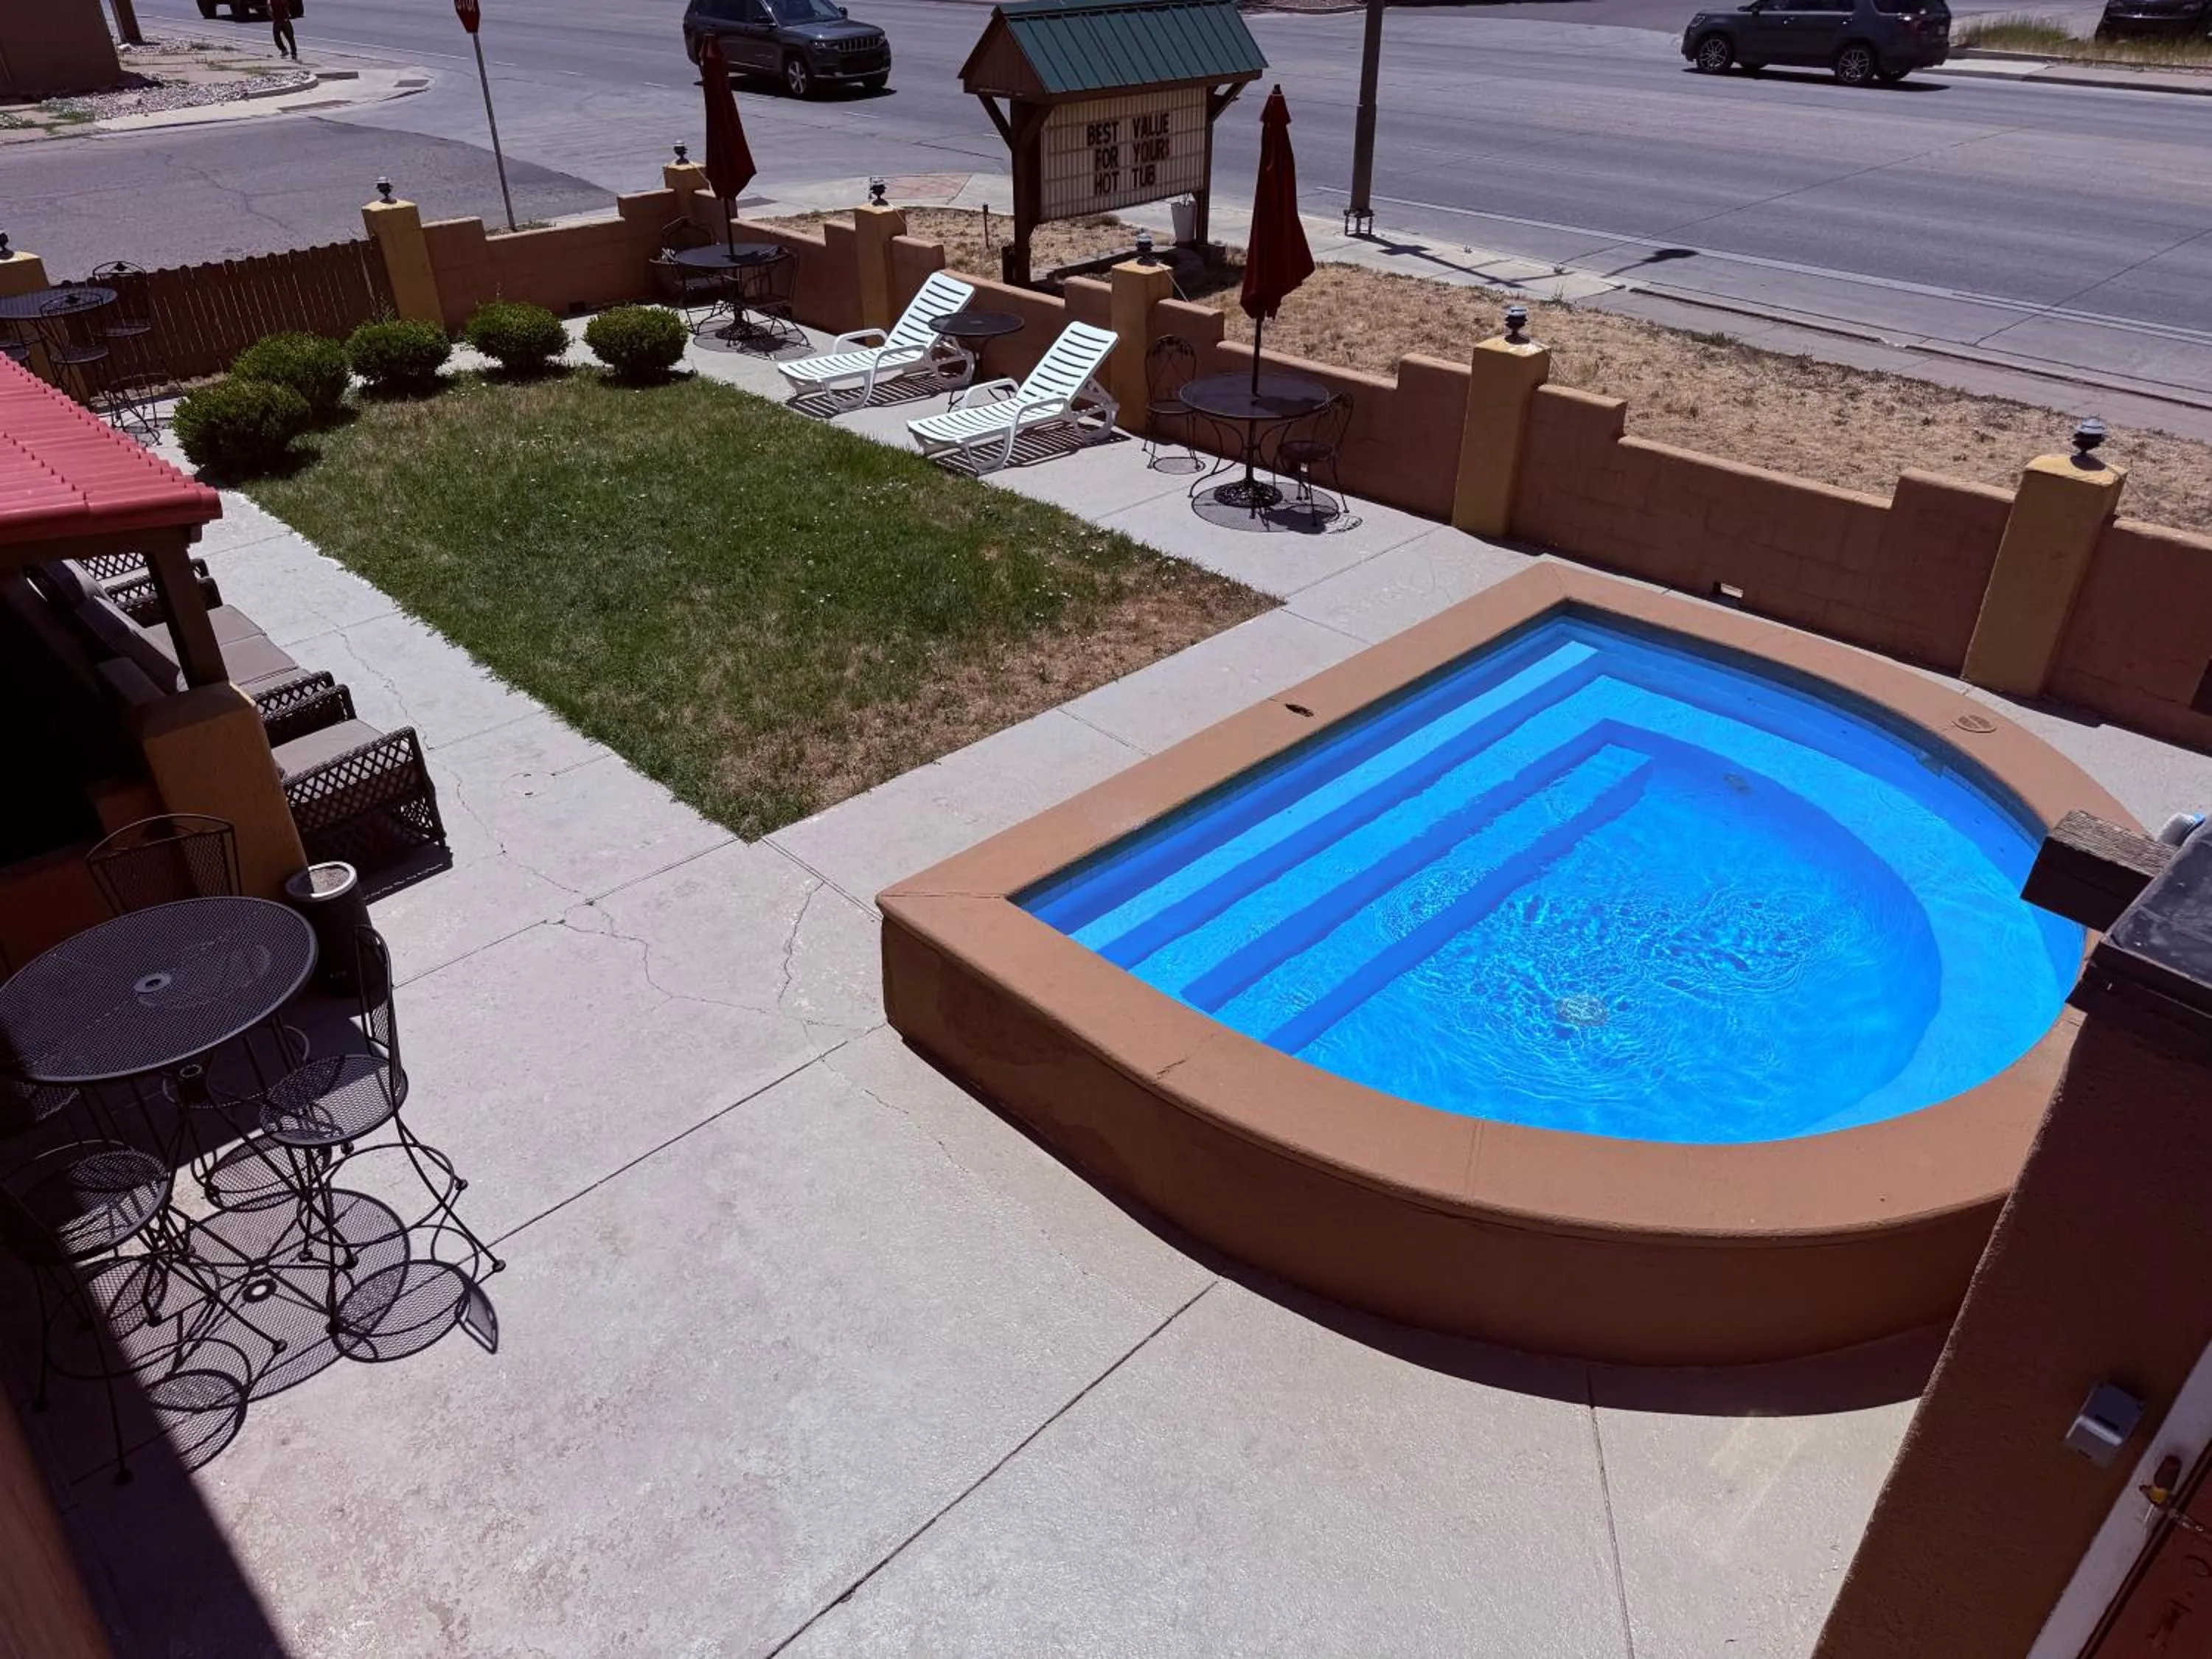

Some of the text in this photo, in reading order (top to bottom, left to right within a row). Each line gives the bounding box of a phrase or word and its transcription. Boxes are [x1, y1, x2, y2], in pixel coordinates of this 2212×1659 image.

[1087, 113, 1169, 146] BEST VALUE
[1095, 146, 1119, 171] FOR
[1095, 164, 1155, 195] HOT TUB
